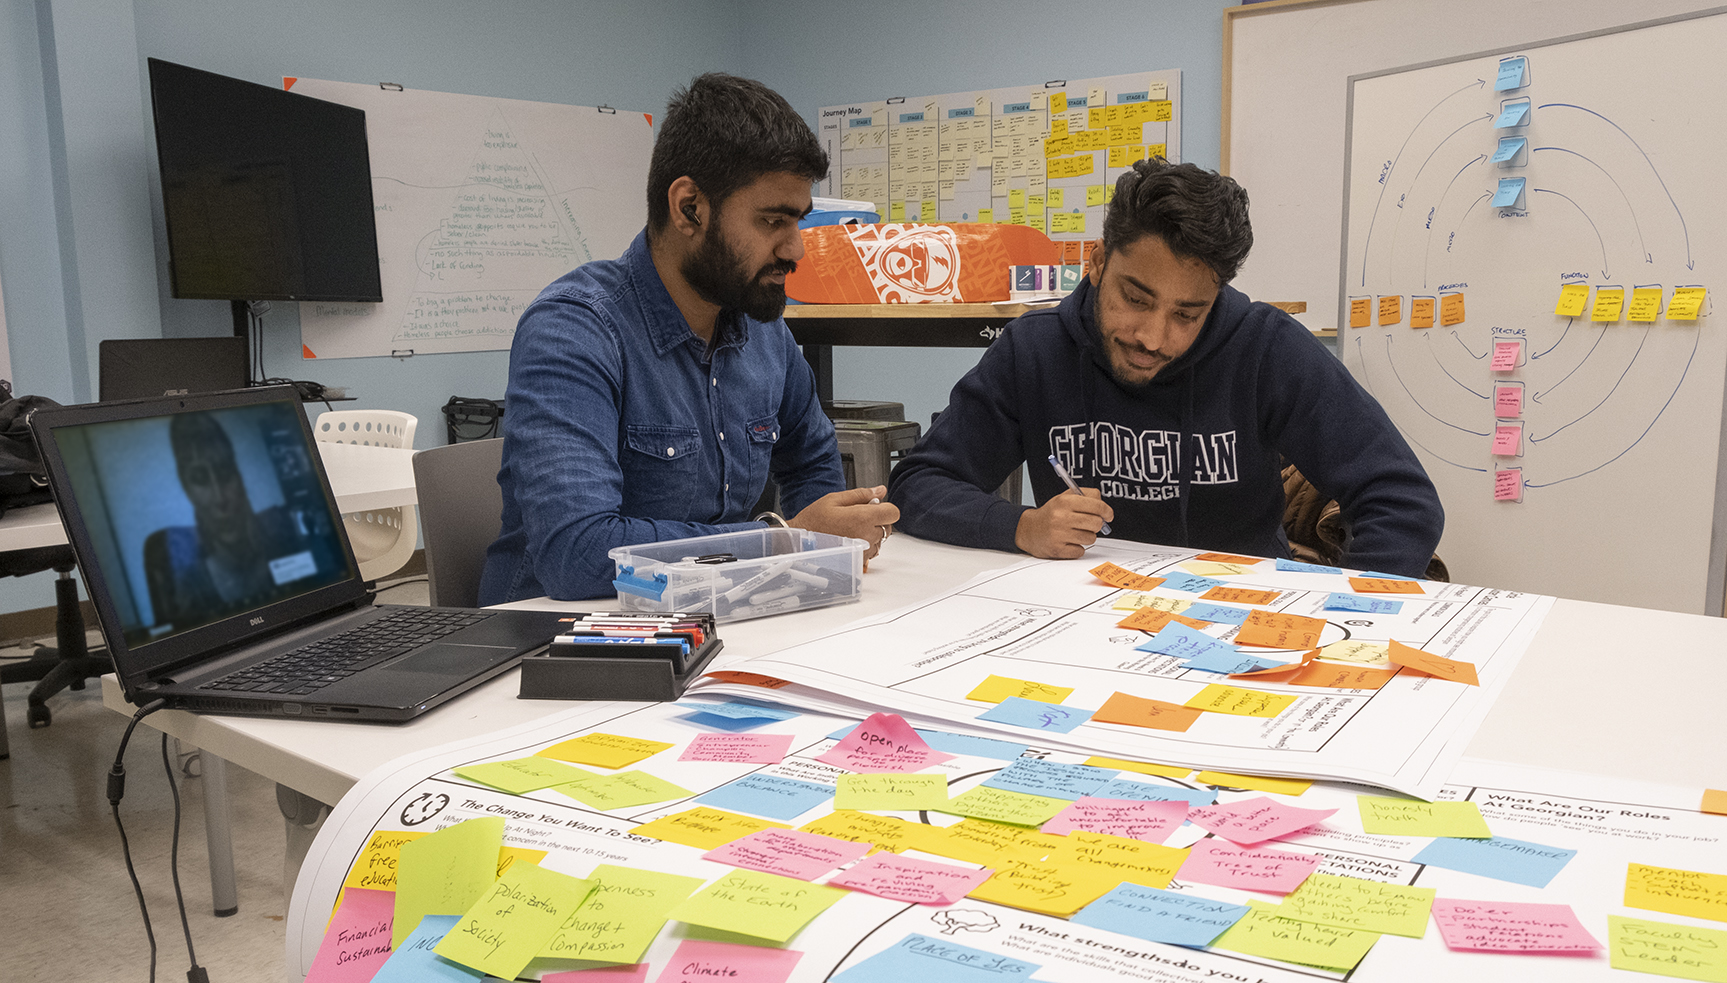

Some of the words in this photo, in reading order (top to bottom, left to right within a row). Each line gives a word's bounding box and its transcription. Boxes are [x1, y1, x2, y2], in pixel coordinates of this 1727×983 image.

[823, 109, 846, 118] Journey
[848, 107, 862, 116] Map
[1560, 272, 1590, 280] FUNCTION
[1491, 326, 1527, 337] STRUCTURE
[1049, 421, 1239, 485] GEORGIAN
[796, 772, 832, 784] Working
[847, 778, 869, 786] Get
[879, 778, 936, 788] through
[850, 786, 880, 794] the
[885, 786, 916, 796] day
[1482, 800, 1505, 810] At
[1510, 802, 1606, 822] Georgian?
[1488, 794, 1534, 805] What
[1540, 800, 1572, 810] Are
[1578, 804, 1614, 816] Our
[1620, 810, 1671, 821] Roles
[460, 799, 484, 810] The
[486, 804, 535, 820] Change
[537, 814, 561, 826] You
[565, 820, 602, 834] Want
[604, 828, 621, 838] To
[622, 832, 662, 846] See?
[1069, 816, 1168, 824] uncomfortable
[1479, 808, 1506, 816] What
[1556, 816, 1573, 824] the
[1574, 820, 1609, 831] things
[1610, 827, 1629, 835] you
[1632, 828, 1648, 836] do
[1664, 834, 1690, 842] your
[1692, 836, 1720, 844] job?
[512, 826, 523, 834] At
[524, 827, 552, 838] Night?
[1314, 827, 1354, 838] guiding
[1354, 834, 1412, 847] principles?
[1520, 819, 1558, 828] people
[1588, 828, 1608, 836] you
[1625, 834, 1661, 842] work?
[507, 836, 537, 846] concern
[547, 840, 561, 850] the
[562, 844, 580, 853] next
[582, 846, 605, 858] 10-15
[605, 851, 629, 862] years
[1342, 837, 1370, 845] show
[368, 852, 397, 869] free
[1209, 848, 1317, 864] Confidentiality
[1314, 852, 1403, 872] PERSONAL
[872, 862, 971, 882] Inspiration
[895, 874, 925, 882] and
[1229, 868, 1285, 878] Trust
[722, 877, 770, 894] State
[780, 890, 808, 900] of
[1296, 887, 1352, 903] others
[1304, 876, 1342, 891] Need
[1352, 886, 1372, 896] to
[1378, 888, 1427, 903] know
[588, 900, 604, 911] to
[710, 889, 736, 901] the
[746, 896, 798, 912] Earth
[1118, 888, 1244, 914] CONNECTION
[496, 904, 514, 918] of
[1105, 898, 1152, 913] FIND
[1174, 912, 1234, 928] FRIEND
[1294, 906, 1314, 917] to
[1322, 912, 1366, 926] share
[336, 914, 395, 946] Financial
[1314, 923, 1354, 938] heard
[1620, 924, 1719, 949] Faculty
[462, 920, 507, 961] Society
[550, 933, 625, 956] Compassion
[901, 937, 958, 958] PLACE
[957, 953, 981, 963] OF
[983, 958, 1028, 974] YES
[1001, 940, 1032, 952] What
[1054, 952, 1117, 974] individuals
[1119, 968, 1147, 981] good
[1008, 934, 1039, 946] What
[1062, 946, 1082, 958] the
[1084, 952, 1112, 964] skills
[1114, 960, 1139, 970] that
[1018, 922, 1071, 941] What
[1201, 967, 1247, 983] you
[1620, 948, 1714, 968] Leader
[682, 962, 739, 978] Climate
